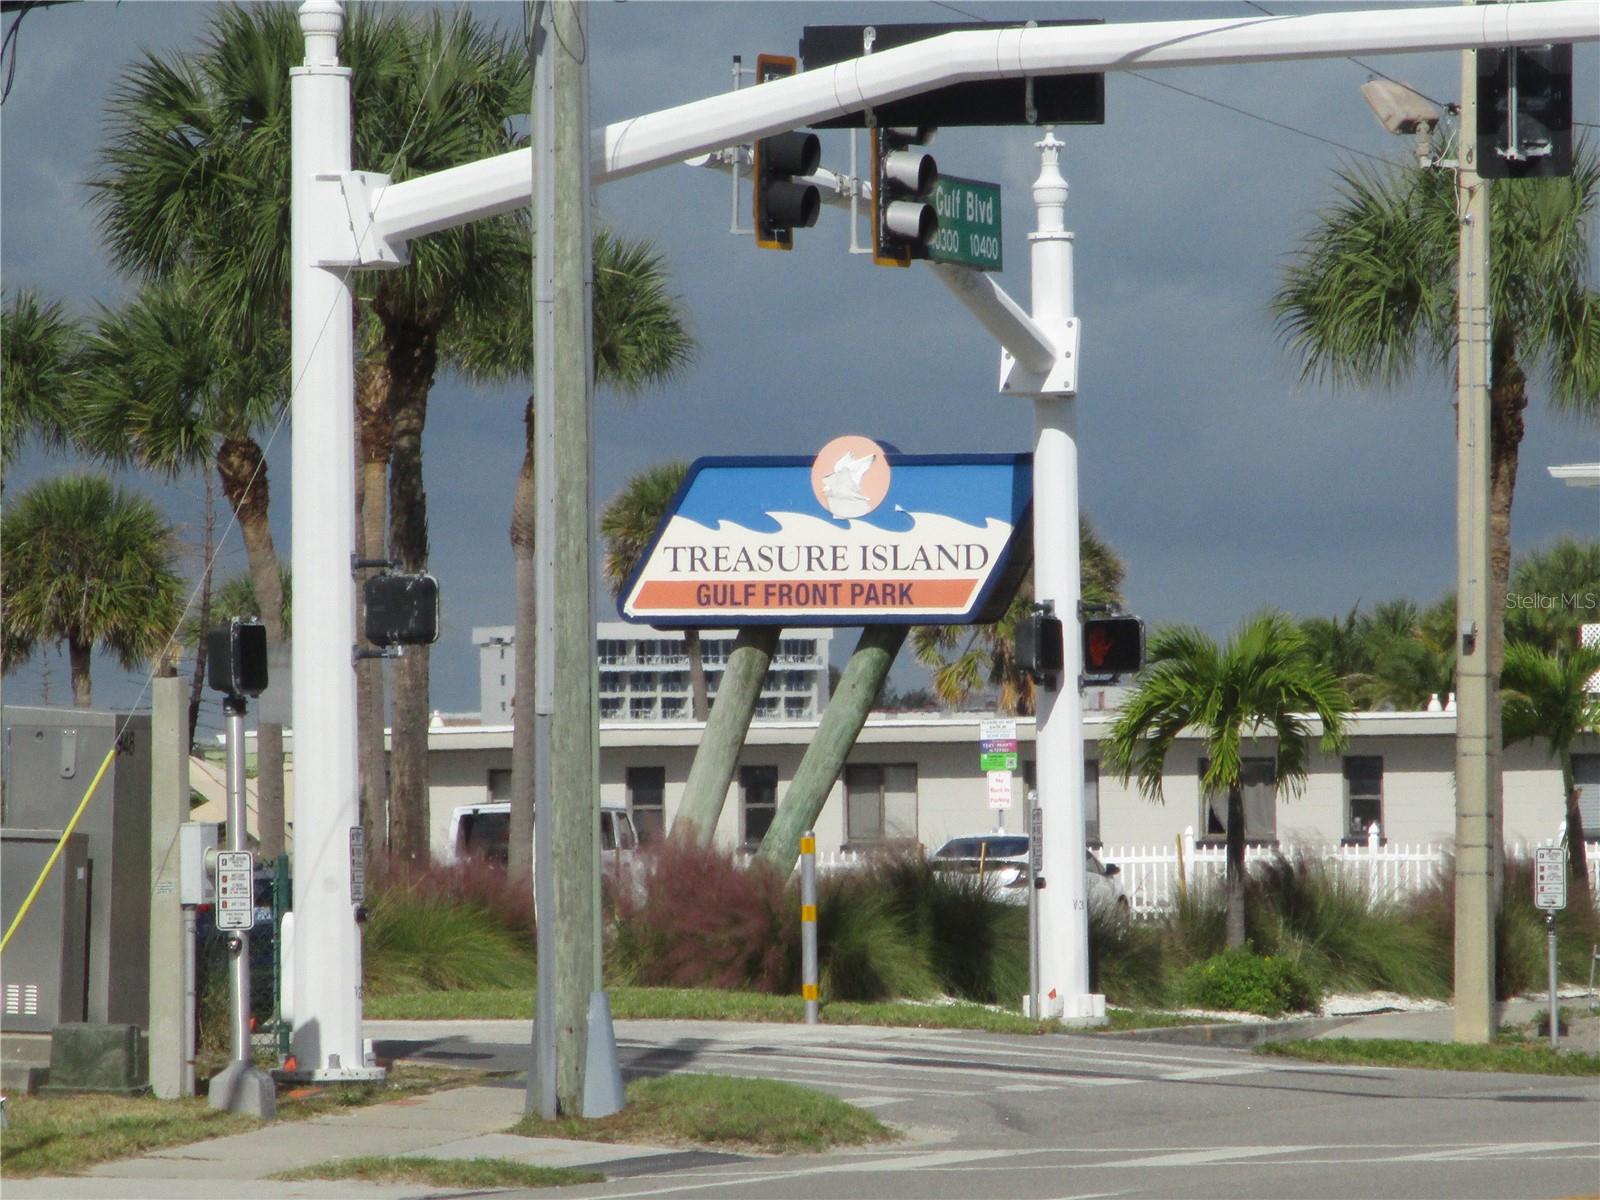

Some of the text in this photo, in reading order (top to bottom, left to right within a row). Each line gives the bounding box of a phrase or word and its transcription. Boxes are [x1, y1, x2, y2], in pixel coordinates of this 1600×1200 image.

[936, 186, 993, 225] Gulf Blvd
[931, 228, 998, 260] 0300 10400
[663, 544, 989, 573] TREASURE ISLAND
[696, 583, 914, 606] GULF FRONT PARK
